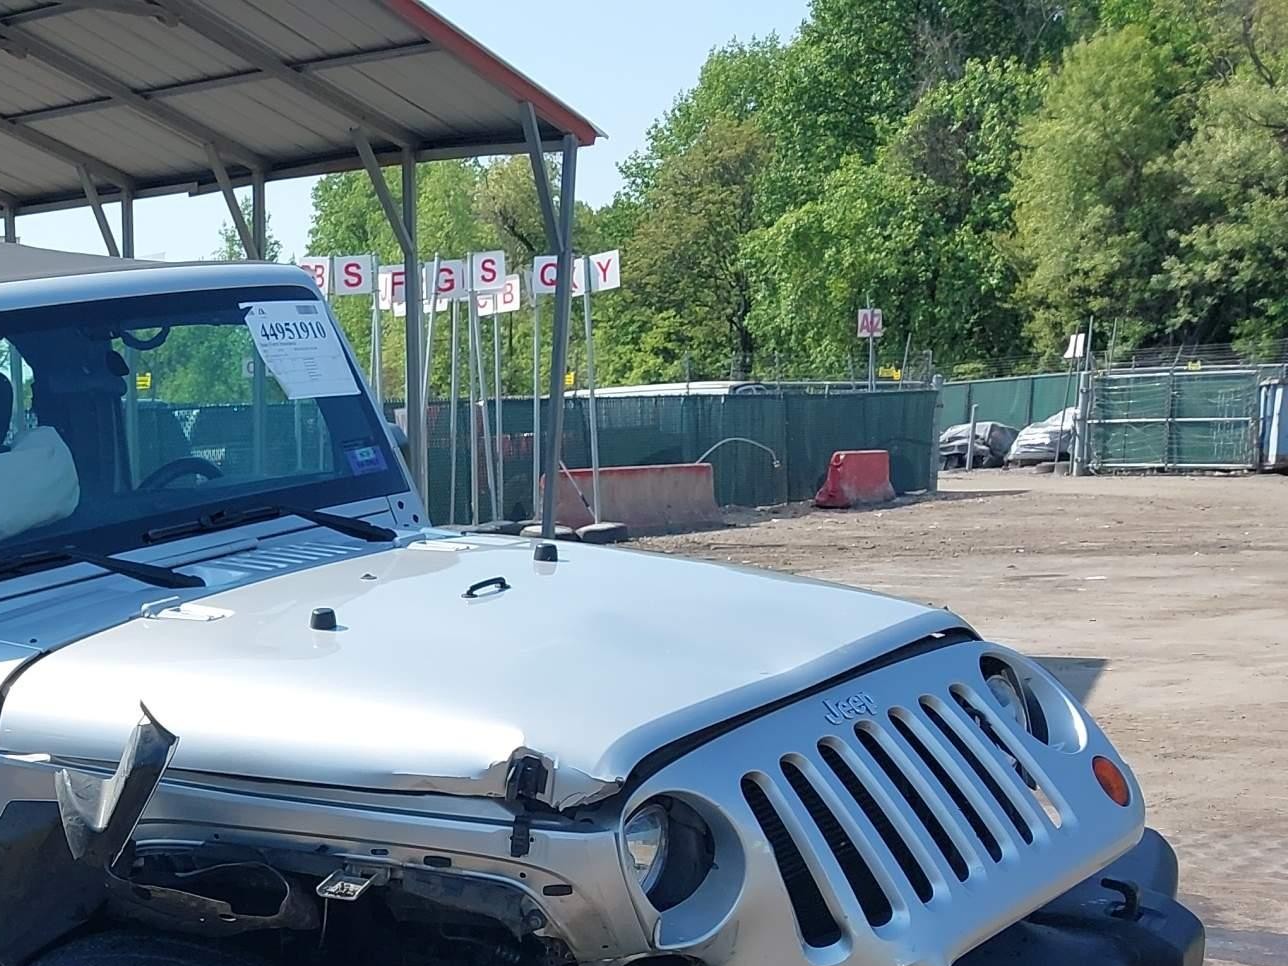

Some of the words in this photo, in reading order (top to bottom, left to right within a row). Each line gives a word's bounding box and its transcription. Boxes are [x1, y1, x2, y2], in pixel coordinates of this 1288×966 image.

[343, 262, 363, 288] S
[481, 258, 497, 283] S
[596, 258, 612, 283] Y
[260, 320, 327, 341] 44951910
[822, 692, 878, 726] Jeep
